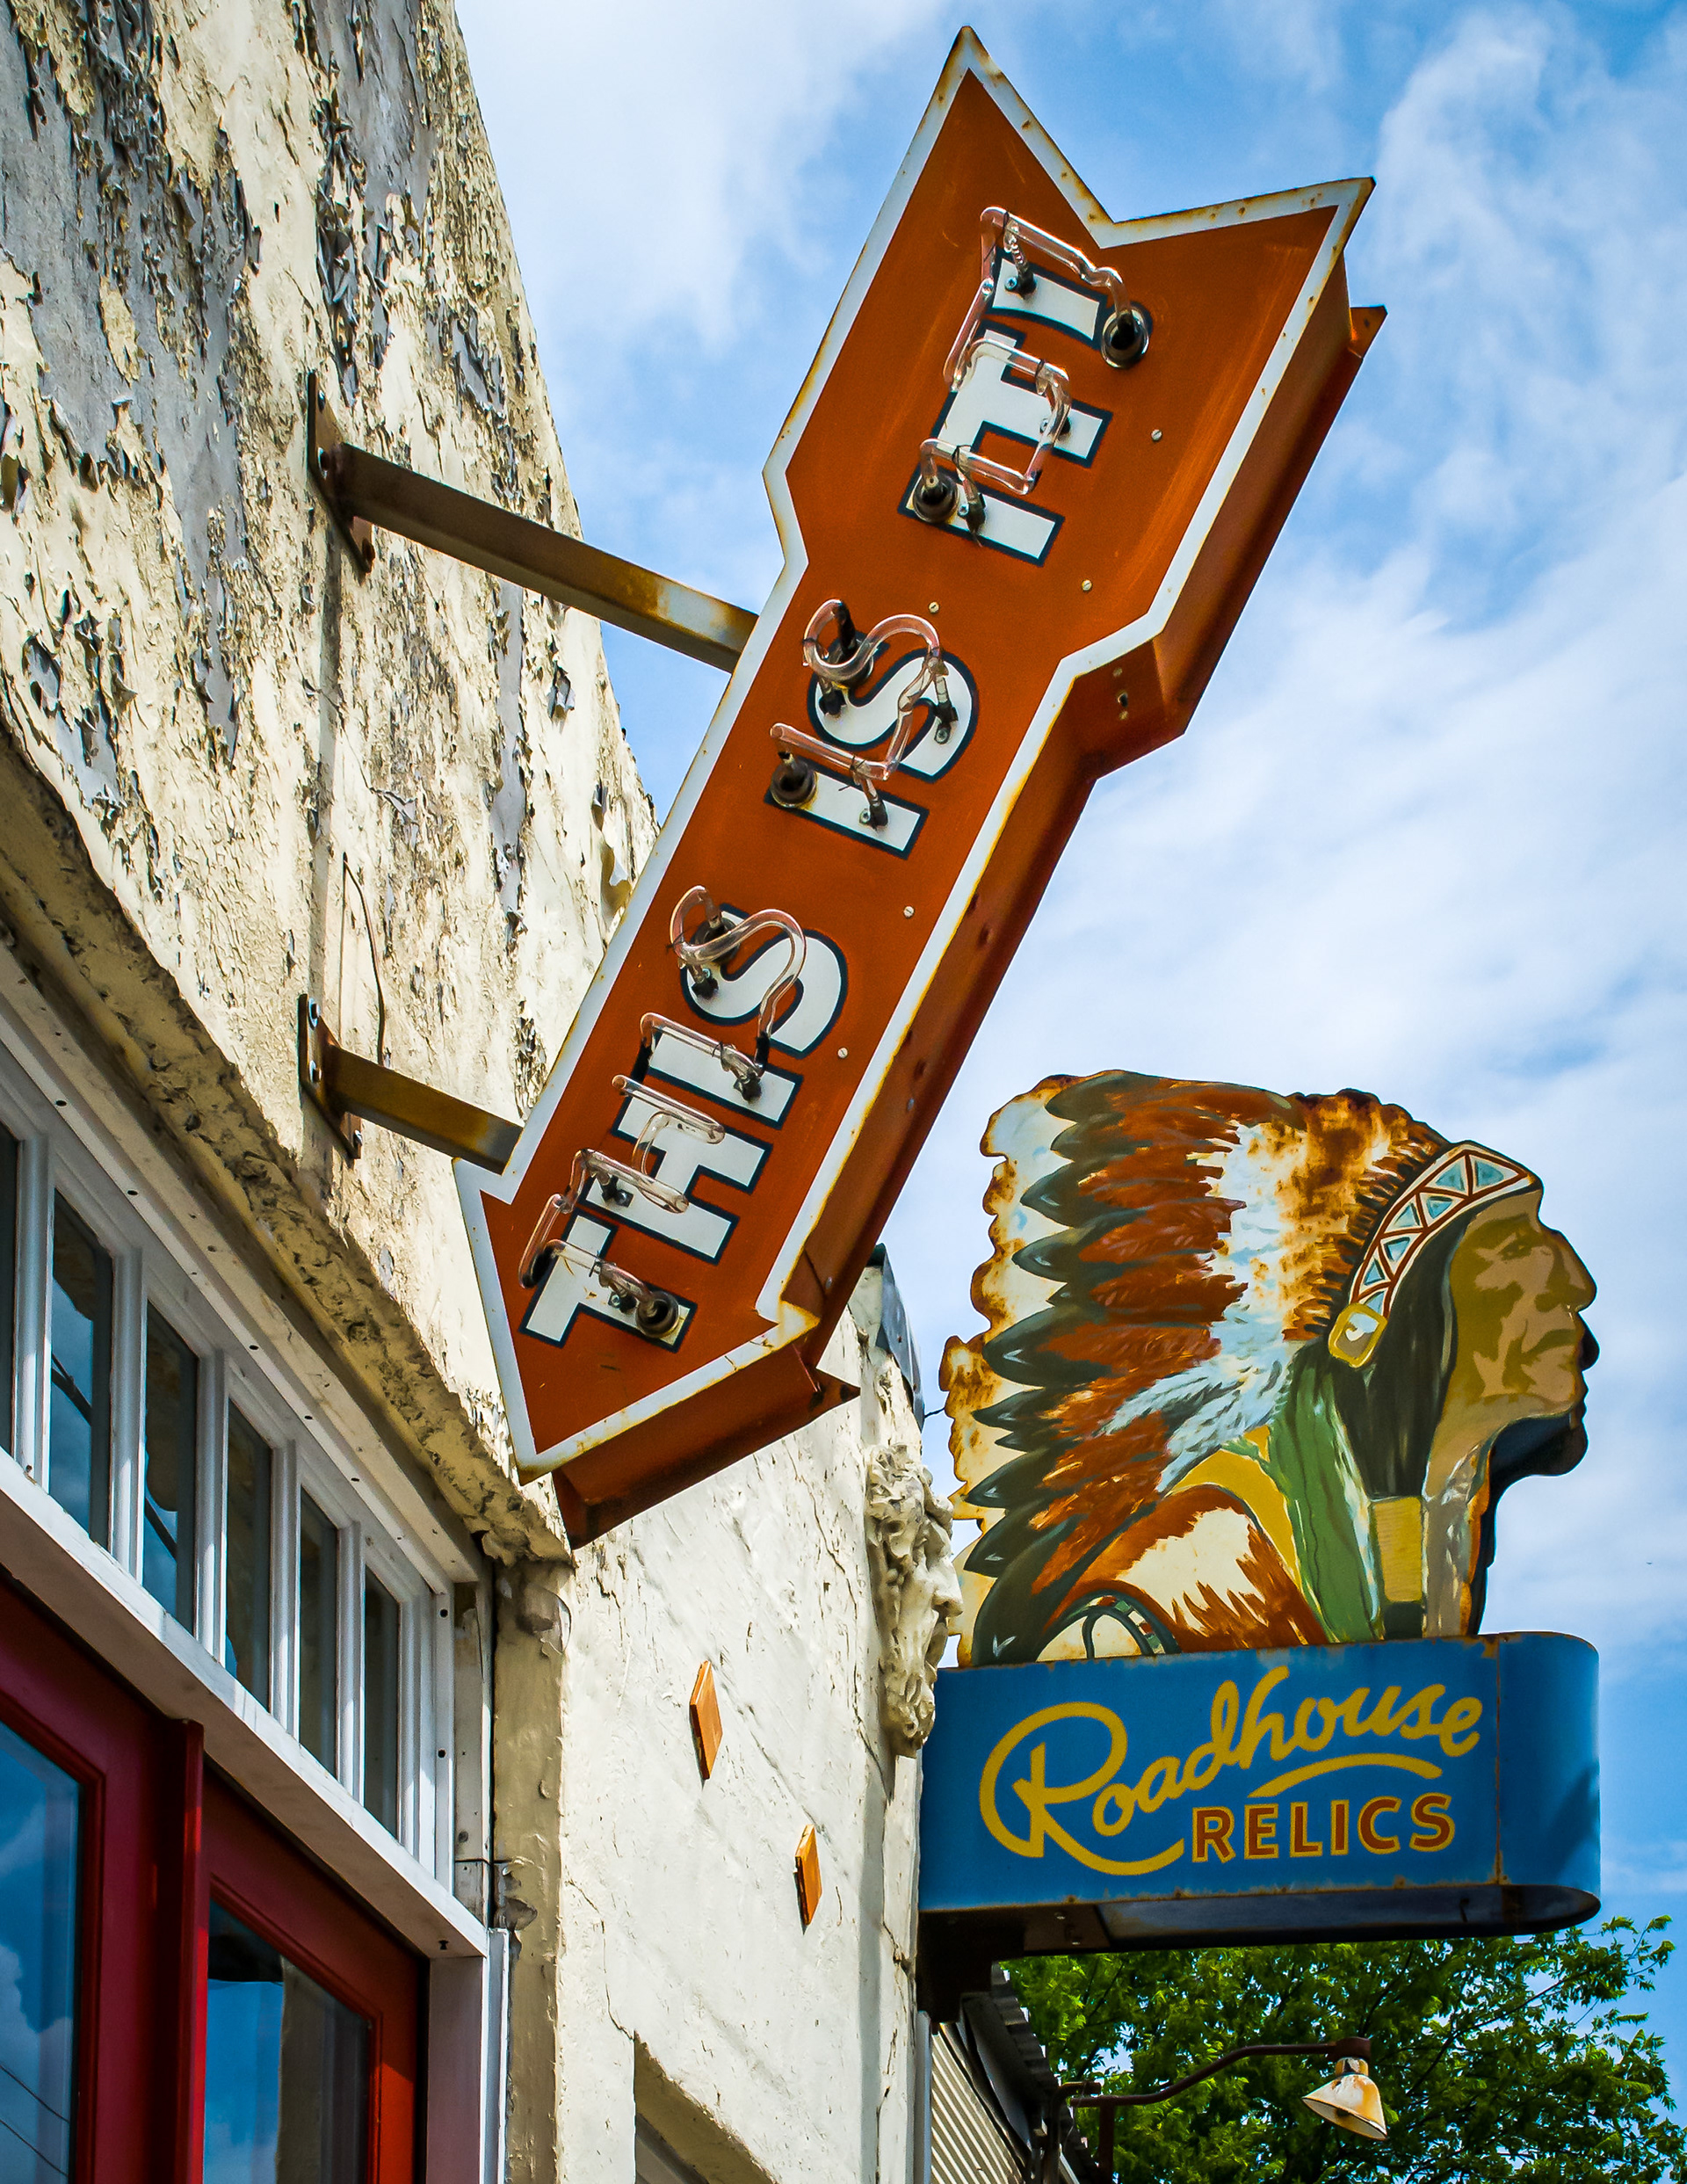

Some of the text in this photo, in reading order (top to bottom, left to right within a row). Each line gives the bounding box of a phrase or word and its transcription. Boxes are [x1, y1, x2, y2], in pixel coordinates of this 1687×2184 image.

[518, 903, 847, 1353] THIS
[764, 630, 978, 859] IS
[980, 1666, 1483, 1876] Roadhouse
[1191, 1793, 1455, 1863] RELICS
